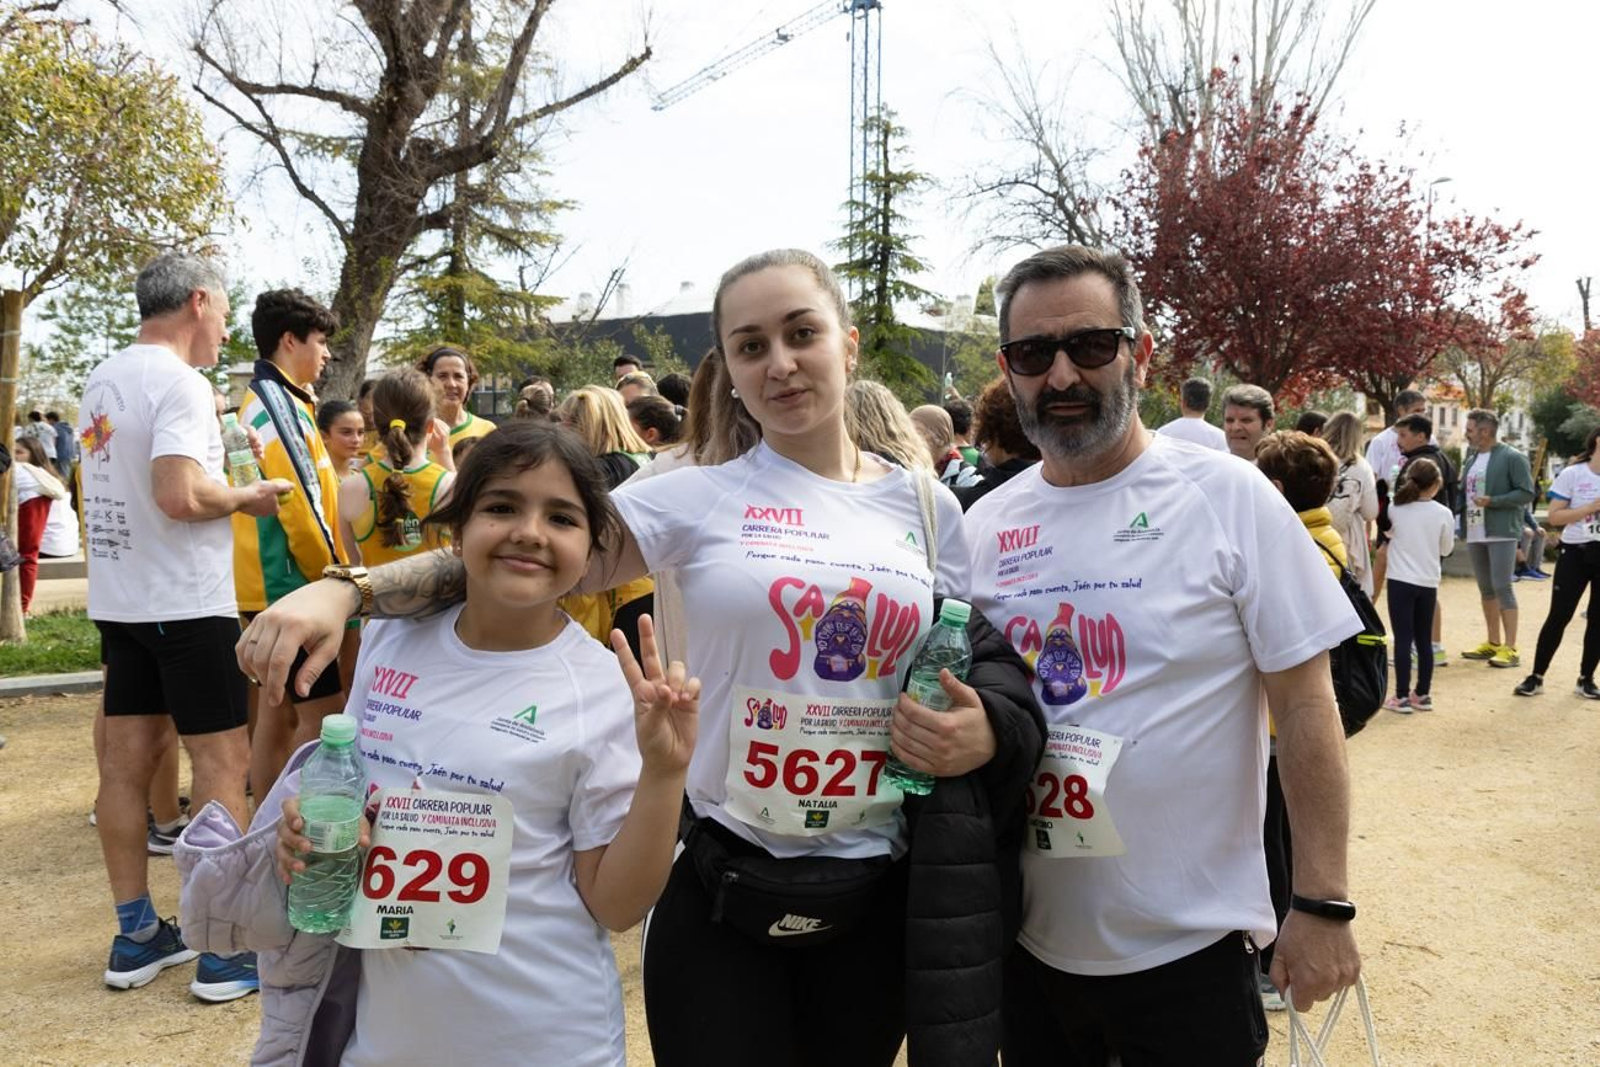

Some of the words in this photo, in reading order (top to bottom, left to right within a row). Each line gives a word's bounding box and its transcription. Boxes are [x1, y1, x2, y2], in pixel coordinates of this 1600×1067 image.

[744, 504, 805, 526] XXVII
[742, 524, 783, 534] CARRERA
[784, 529, 830, 540] POPULAR
[997, 525, 1041, 554] XXVII
[745, 550, 777, 560] Porque
[780, 554, 801, 562] cada
[1021, 545, 1054, 561] POPULAR
[1073, 580, 1091, 592] Jaén
[1094, 582, 1106, 591] por
[1121, 577, 1142, 589] salud
[768, 575, 921, 681] SALUD
[372, 666, 419, 699] XXVII
[382, 703, 422, 721] POPULAR
[744, 697, 788, 730] SALUD
[806, 703, 831, 717] XXVII
[831, 706, 862, 717] CARRERA
[801, 717, 813, 727] POR
[1065, 732, 1101, 748] POPULAR
[743, 740, 887, 797] 5627
[426, 763, 448, 777] Jaén
[450, 771, 464, 782] por
[467, 775, 477, 785] tu
[480, 777, 505, 792] salud
[385, 796, 412, 810] XXVII
[412, 798, 449, 813] CARRERA
[450, 801, 492, 815] POPULAR
[798, 799, 838, 809] NATALIA
[391, 811, 399, 821] LA
[400, 812, 419, 822] SALUD
[421, 814, 428, 823] Y
[428, 815, 461, 826] CAMINATA
[461, 817, 497, 828] INCLUSIVA
[376, 905, 414, 915] MARIA
[779, 913, 821, 930] NIKE
